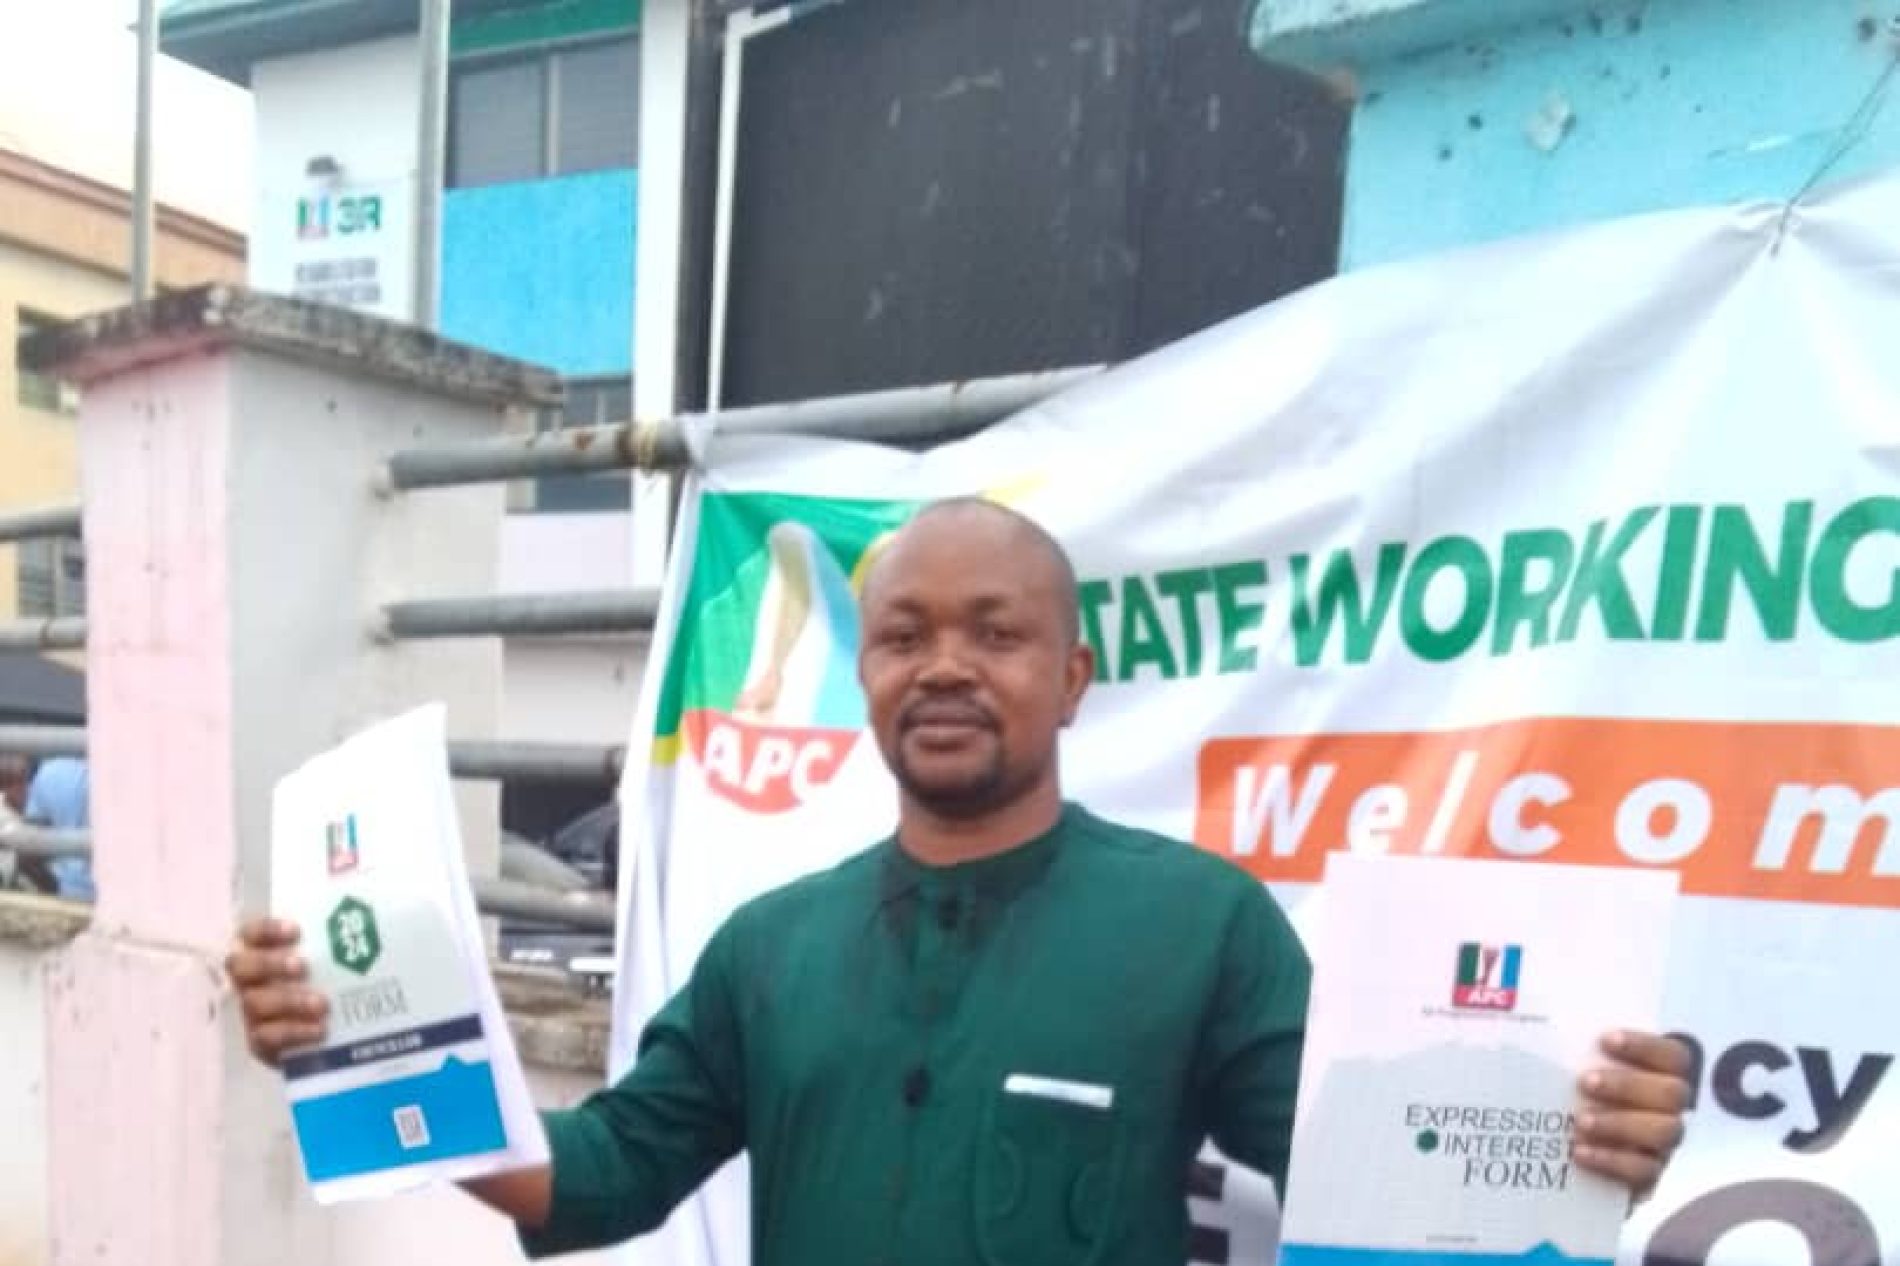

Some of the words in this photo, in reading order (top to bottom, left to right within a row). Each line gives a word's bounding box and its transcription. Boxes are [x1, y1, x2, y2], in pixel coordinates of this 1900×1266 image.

[1288, 495, 1900, 668] WORKING
[702, 723, 834, 796] APC
[1463, 1159, 1570, 1190] FORM
